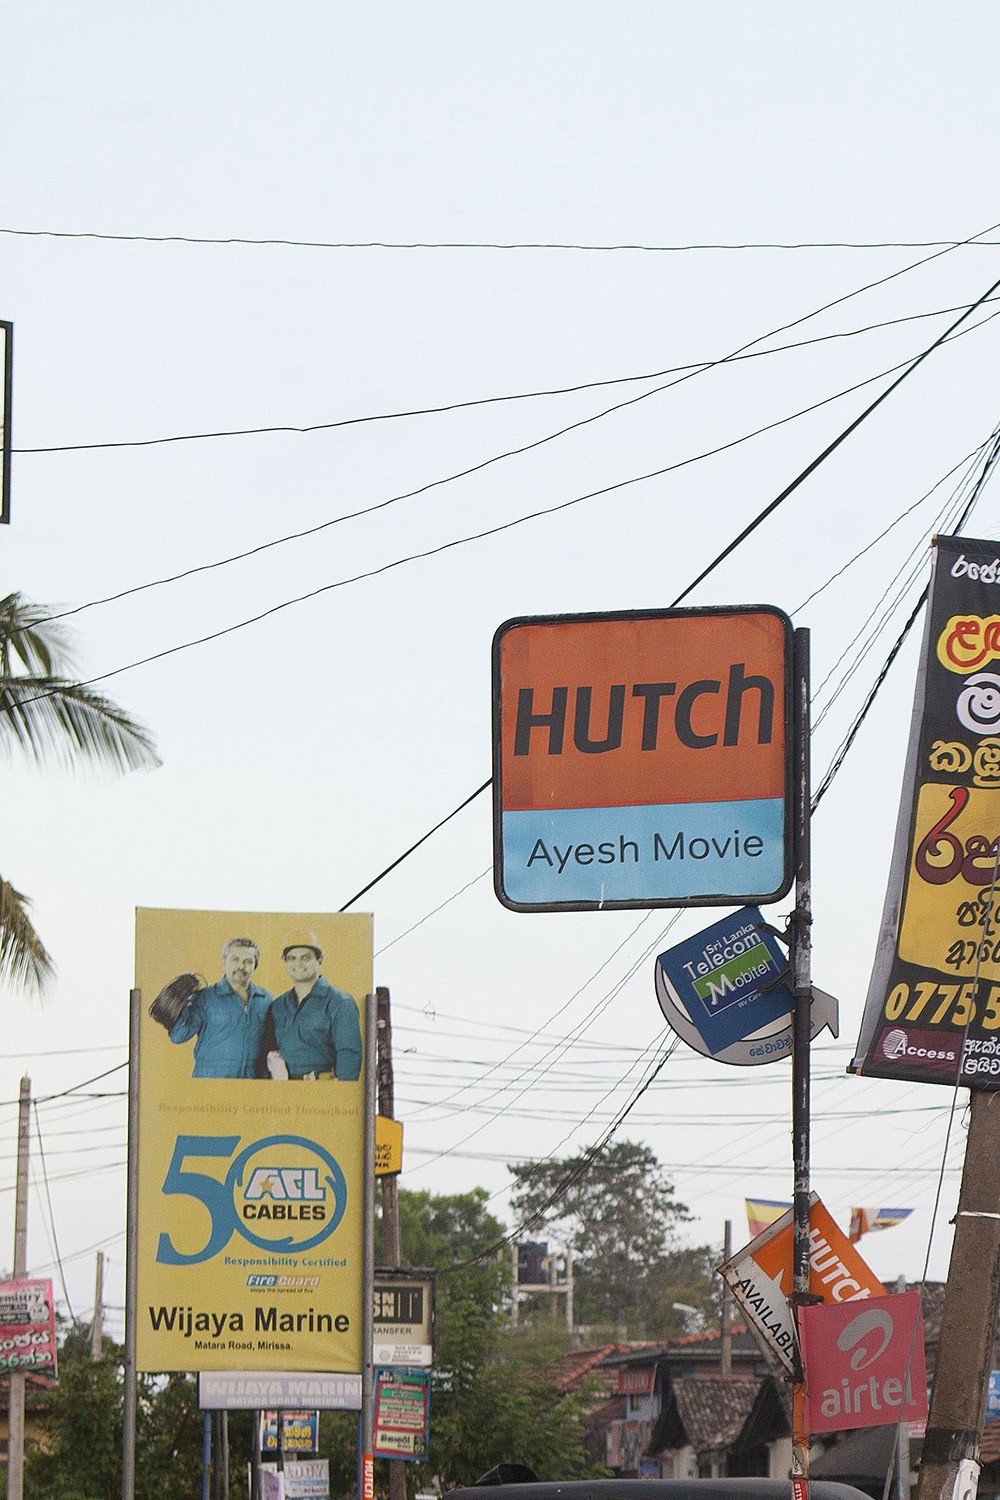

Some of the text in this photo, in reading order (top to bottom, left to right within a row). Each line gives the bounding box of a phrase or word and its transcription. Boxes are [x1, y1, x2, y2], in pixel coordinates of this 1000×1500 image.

[527, 830, 764, 874] Ayesh Movie
[706, 923, 755, 955] Sri Lanka
[683, 931, 762, 980] Telecom
[705, 960, 771, 1005] Mobitel
[884, 981, 978, 1026] 0775
[893, 1033, 956, 1061] Access
[159, 1103, 360, 1117] Responsibility Certified Throughout
[244, 1167, 326, 1201] ACL
[243, 1204, 325, 1220] CABLES
[224, 1256, 347, 1268] Responsibility Certified
[149, 1306, 350, 1338] Wijaya Marine
[195, 1341, 293, 1351] Matara Road, Mirissa.
[206, 1381, 360, 1396] WIJAYA MARIN
[821, 1371, 917, 1418] airtel
